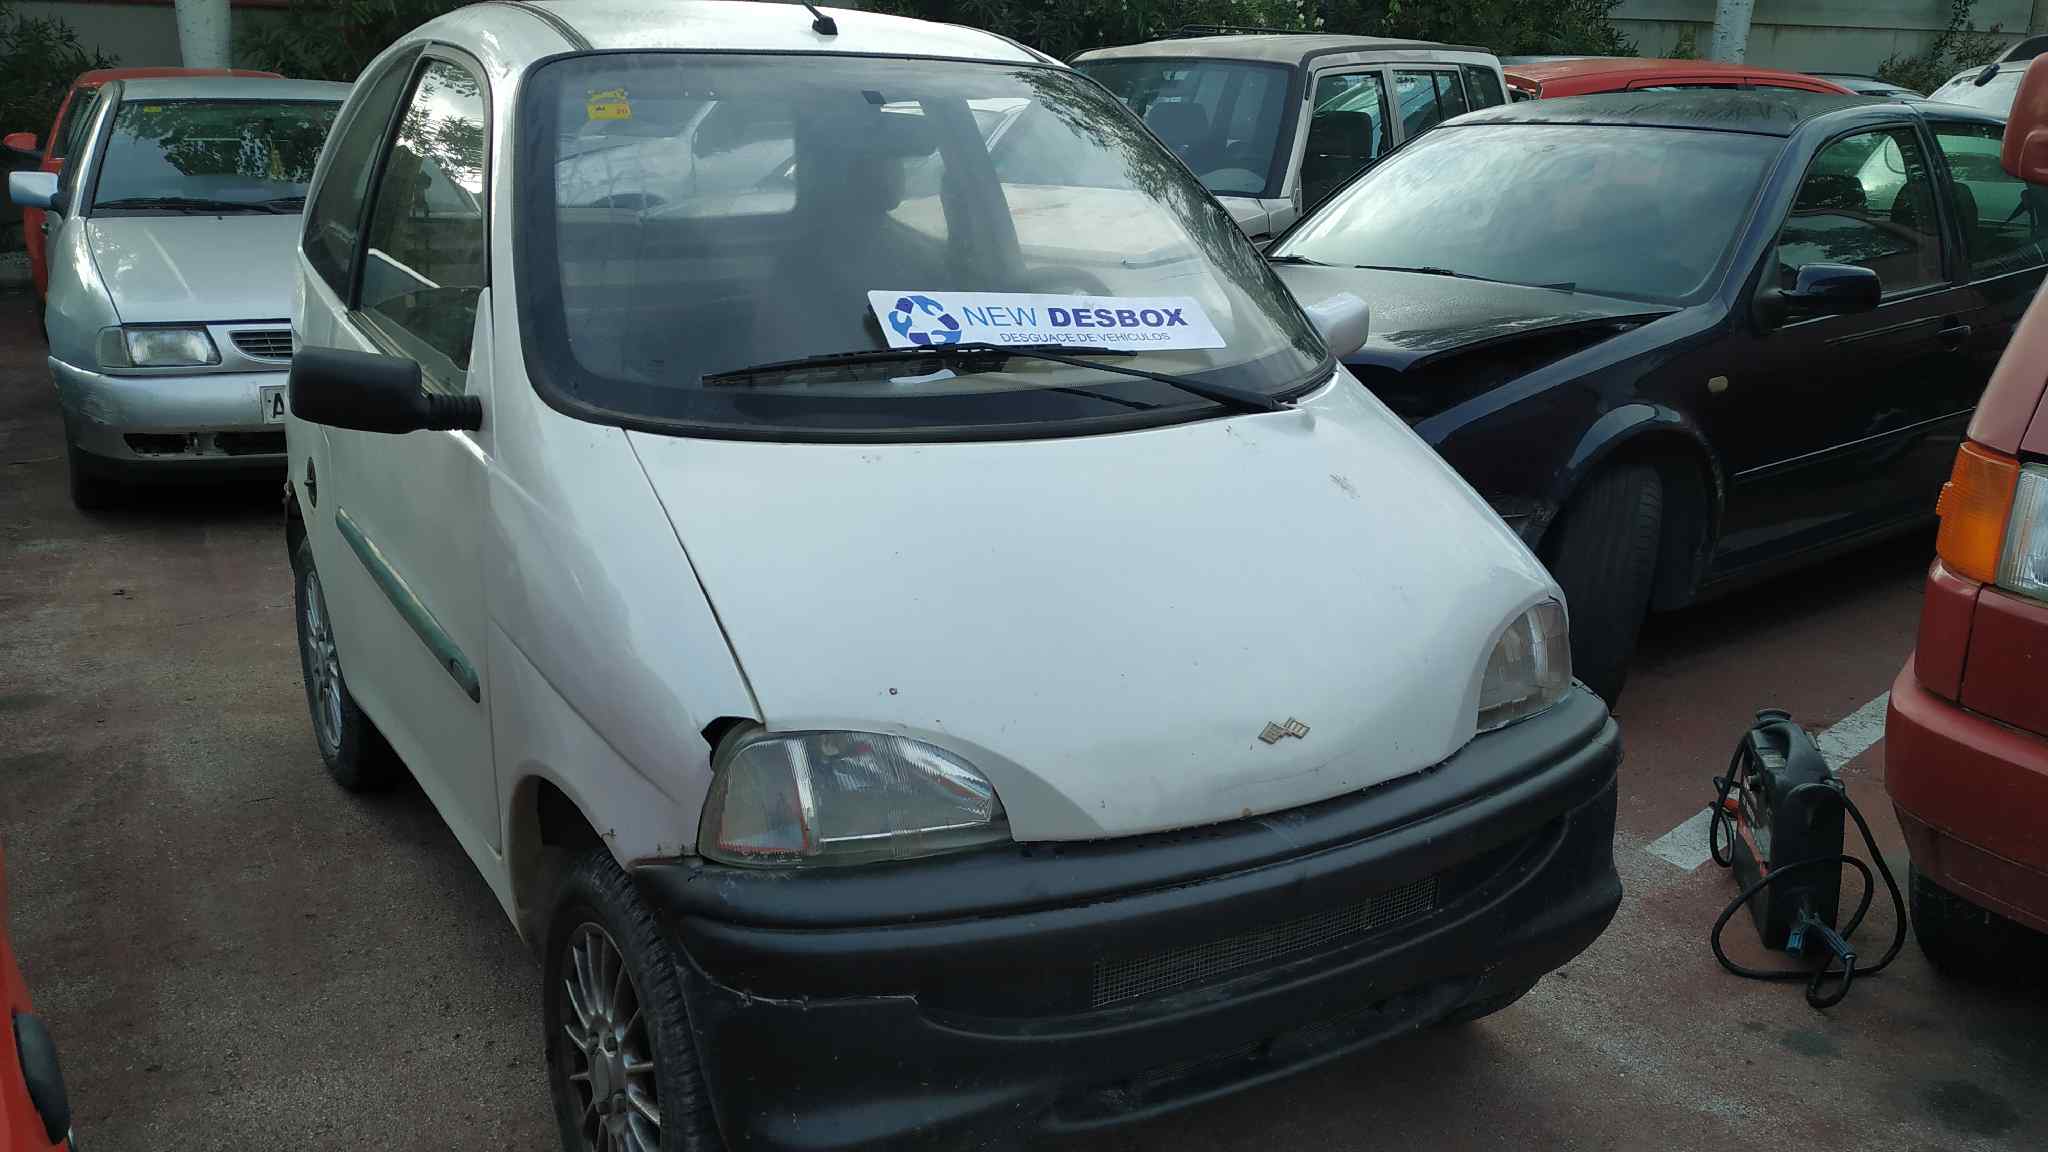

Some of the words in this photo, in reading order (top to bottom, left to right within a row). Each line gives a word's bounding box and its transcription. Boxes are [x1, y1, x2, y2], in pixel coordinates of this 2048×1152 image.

[962, 306, 1037, 327] NEW
[1048, 307, 1188, 328] DESBOX
[999, 333, 1075, 343] DESGUACE
[1076, 333, 1097, 342] DE
